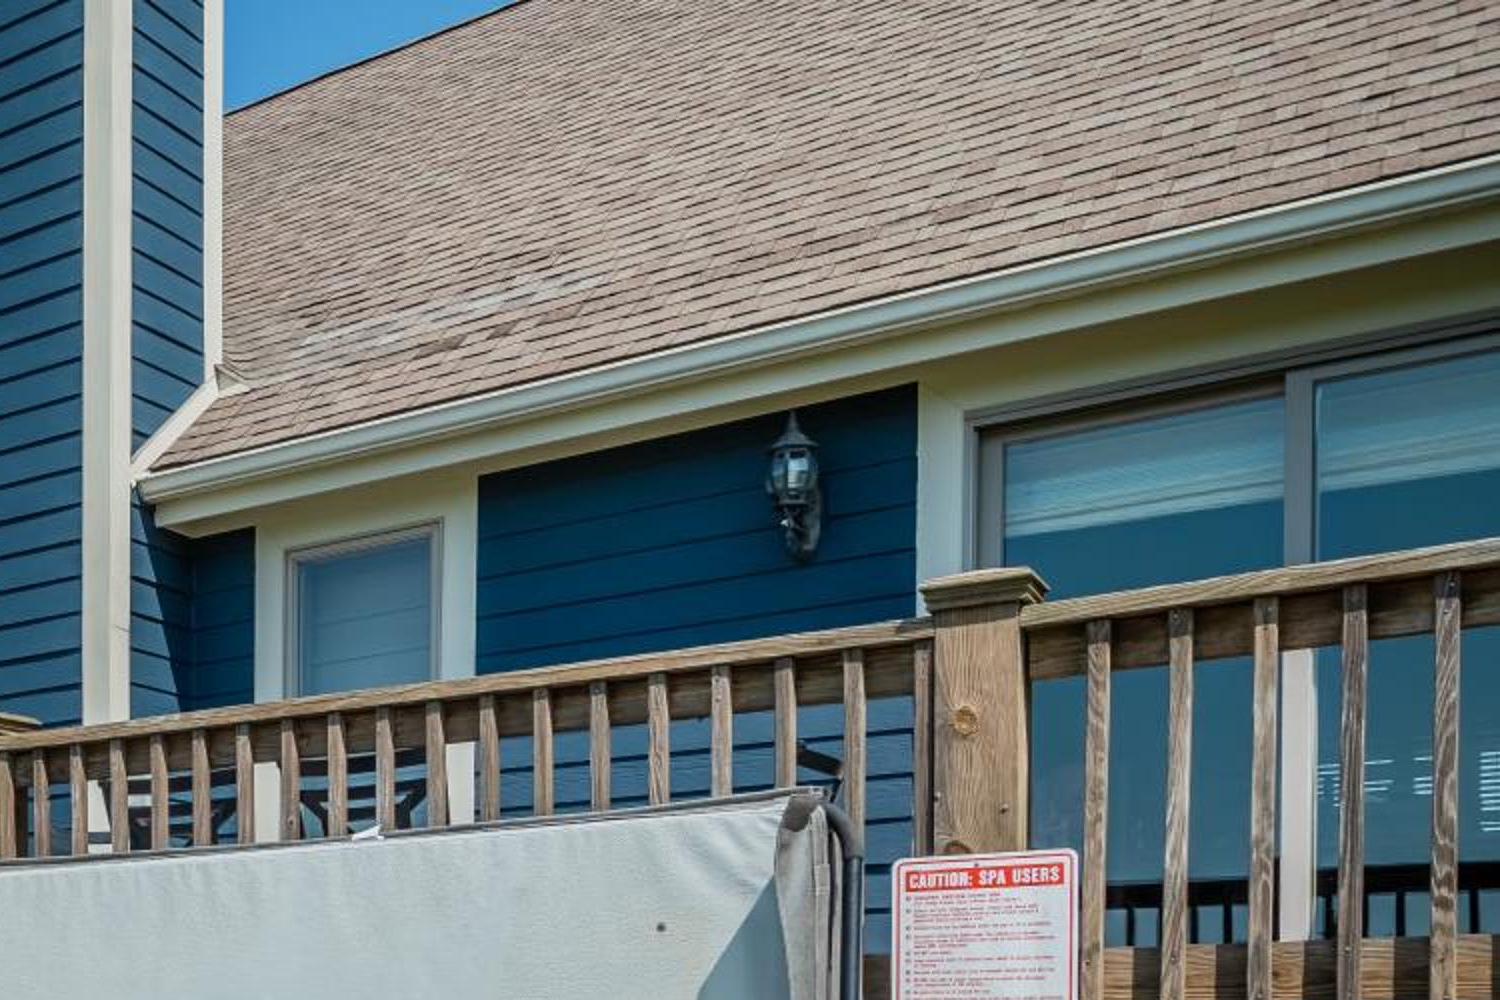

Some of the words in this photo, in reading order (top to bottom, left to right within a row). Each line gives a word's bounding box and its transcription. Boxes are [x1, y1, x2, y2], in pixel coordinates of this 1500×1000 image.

[909, 872, 973, 889] CAUTION:
[979, 869, 1006, 886] SPA
[1012, 866, 1060, 883] USERS
